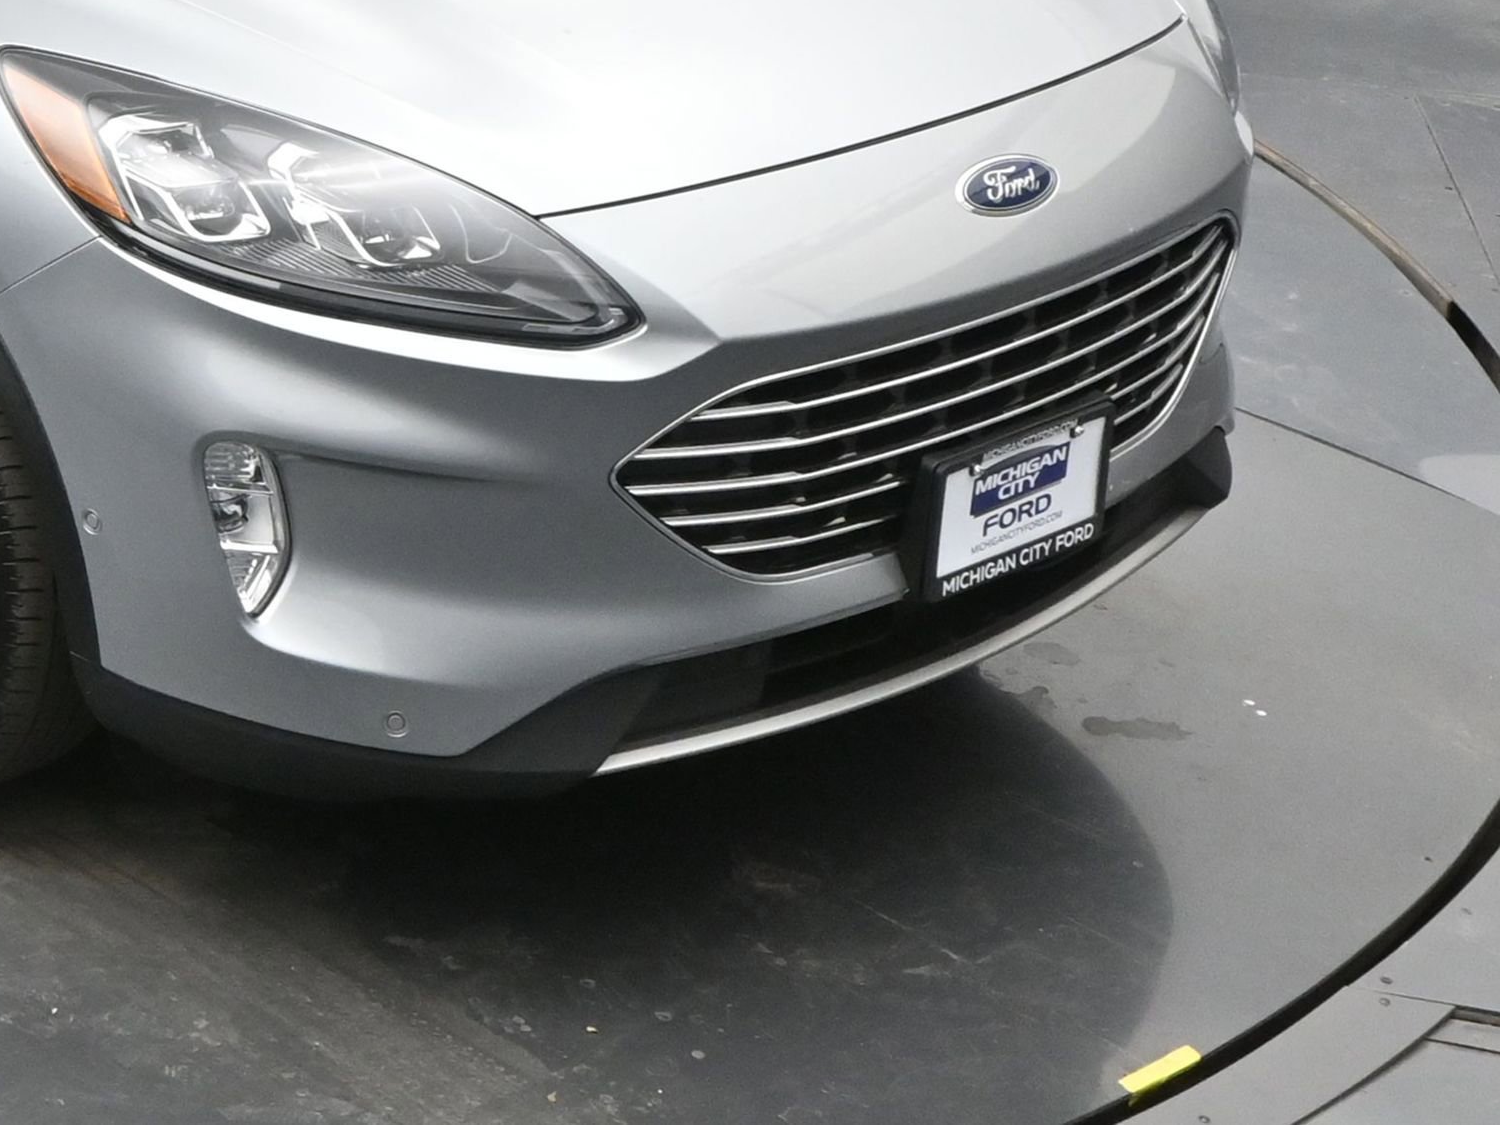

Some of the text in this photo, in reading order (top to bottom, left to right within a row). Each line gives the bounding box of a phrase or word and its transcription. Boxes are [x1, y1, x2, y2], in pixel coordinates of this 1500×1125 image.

[983, 165, 1040, 203] Ford
[975, 445, 1068, 496] MICHIGAN
[998, 472, 1040, 500] CITY
[982, 493, 1052, 537] FORD
[942, 523, 1094, 596] MICHIGAN CITY FORD
